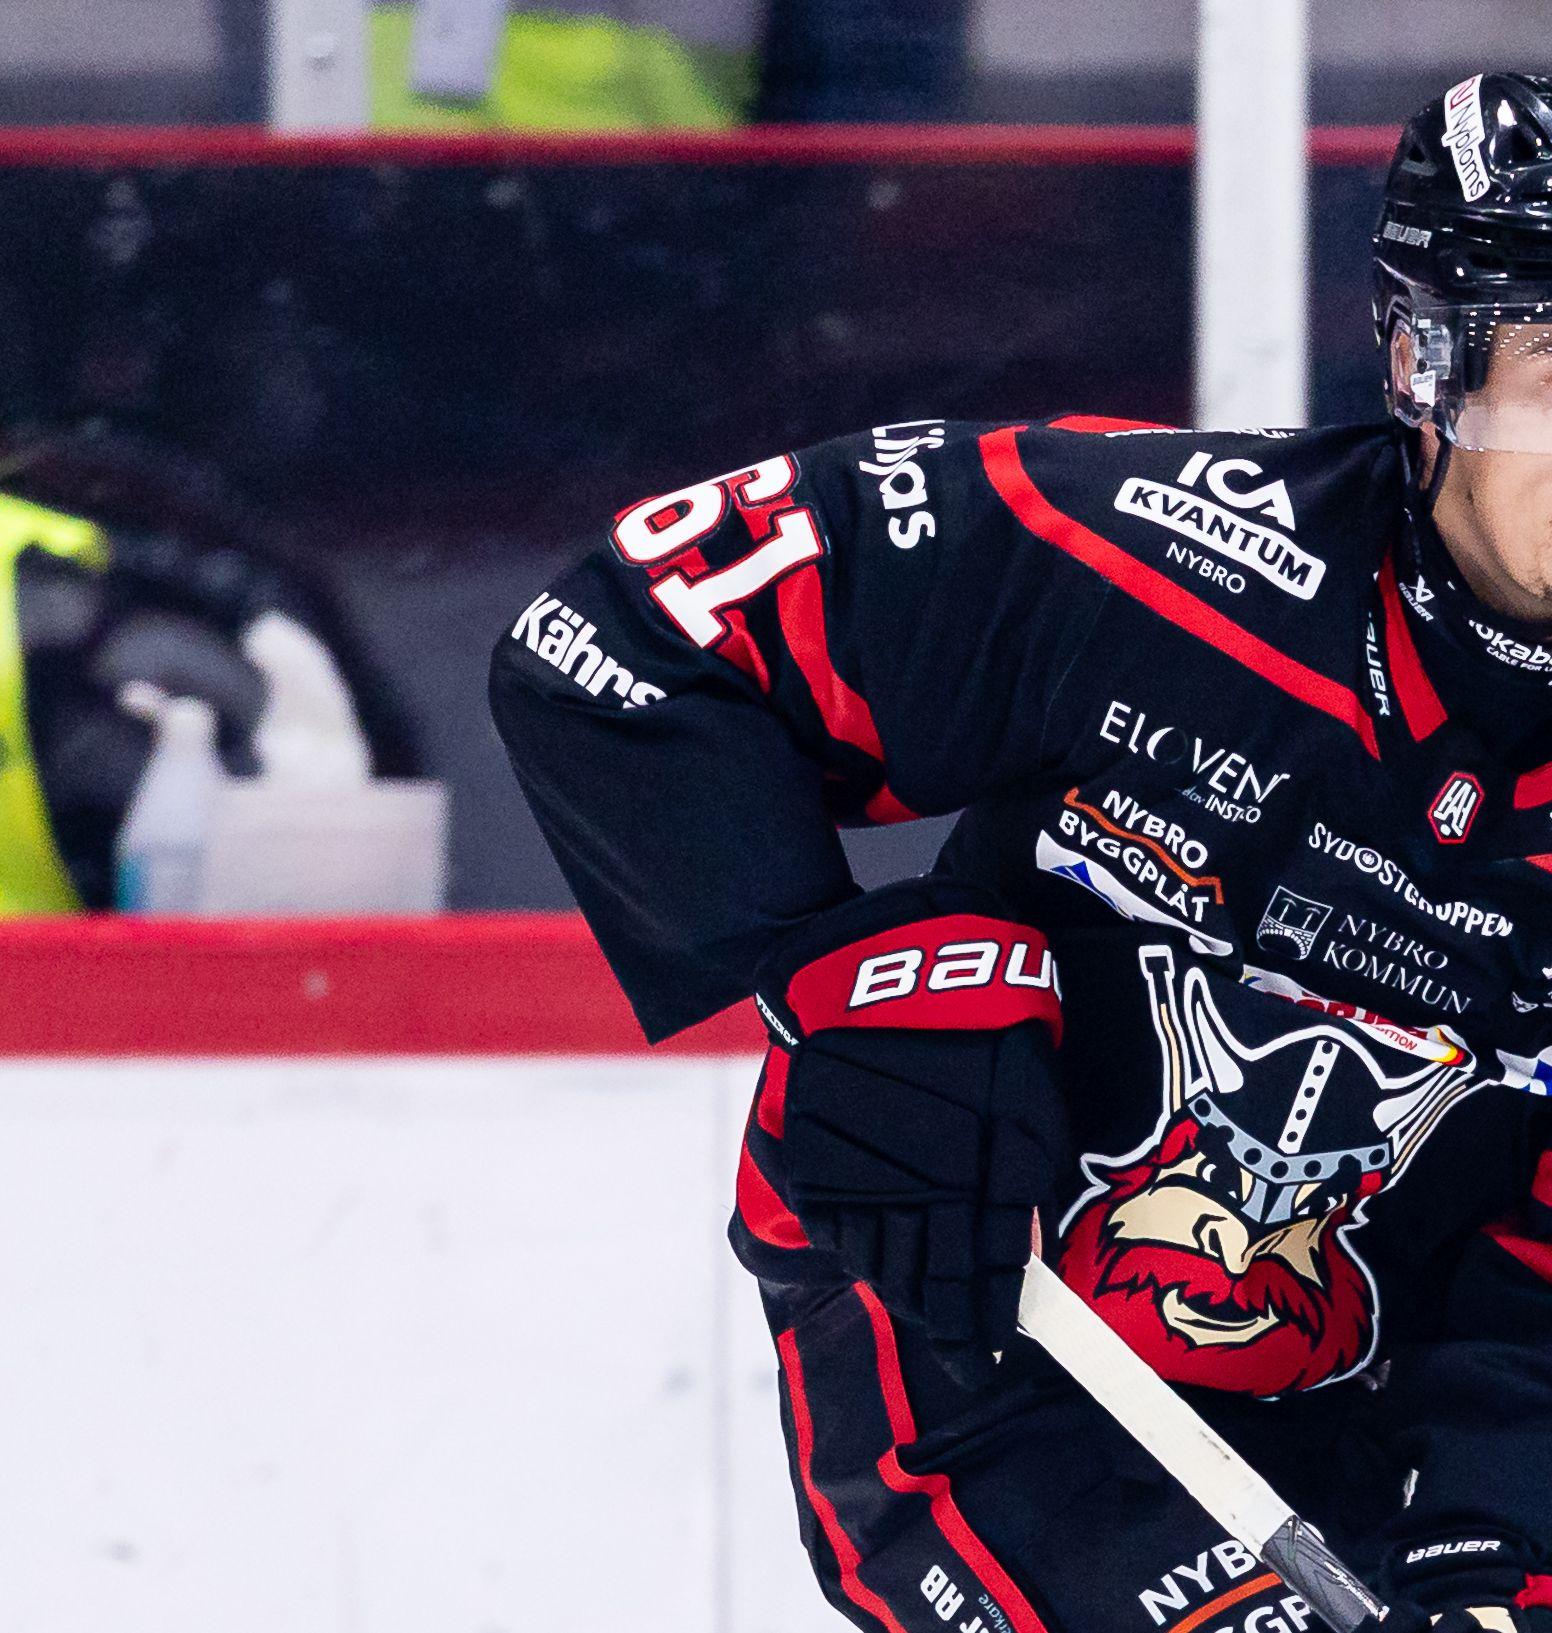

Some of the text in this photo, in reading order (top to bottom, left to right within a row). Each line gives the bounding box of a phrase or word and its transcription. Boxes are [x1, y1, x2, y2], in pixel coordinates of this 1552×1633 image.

[1176, 451, 1297, 532] ICA
[611, 452, 828, 650] 61
[1129, 486, 1313, 587] KVANTUM
[1165, 541, 1246, 595] NYBRO
[1366, 621, 1391, 716] AUER
[1058, 809, 1210, 923] BYGGPLÅT
[1102, 790, 1209, 869] NYBRO
[849, 941, 1062, 1008] BAU
[1322, 941, 1471, 1014] KOMMUN
[1337, 914, 1448, 970] NYBRO
[1137, 1539, 1258, 1627] NYB
[1405, 1540, 1501, 1564] BAUER
[919, 1564, 965, 1622] AB
